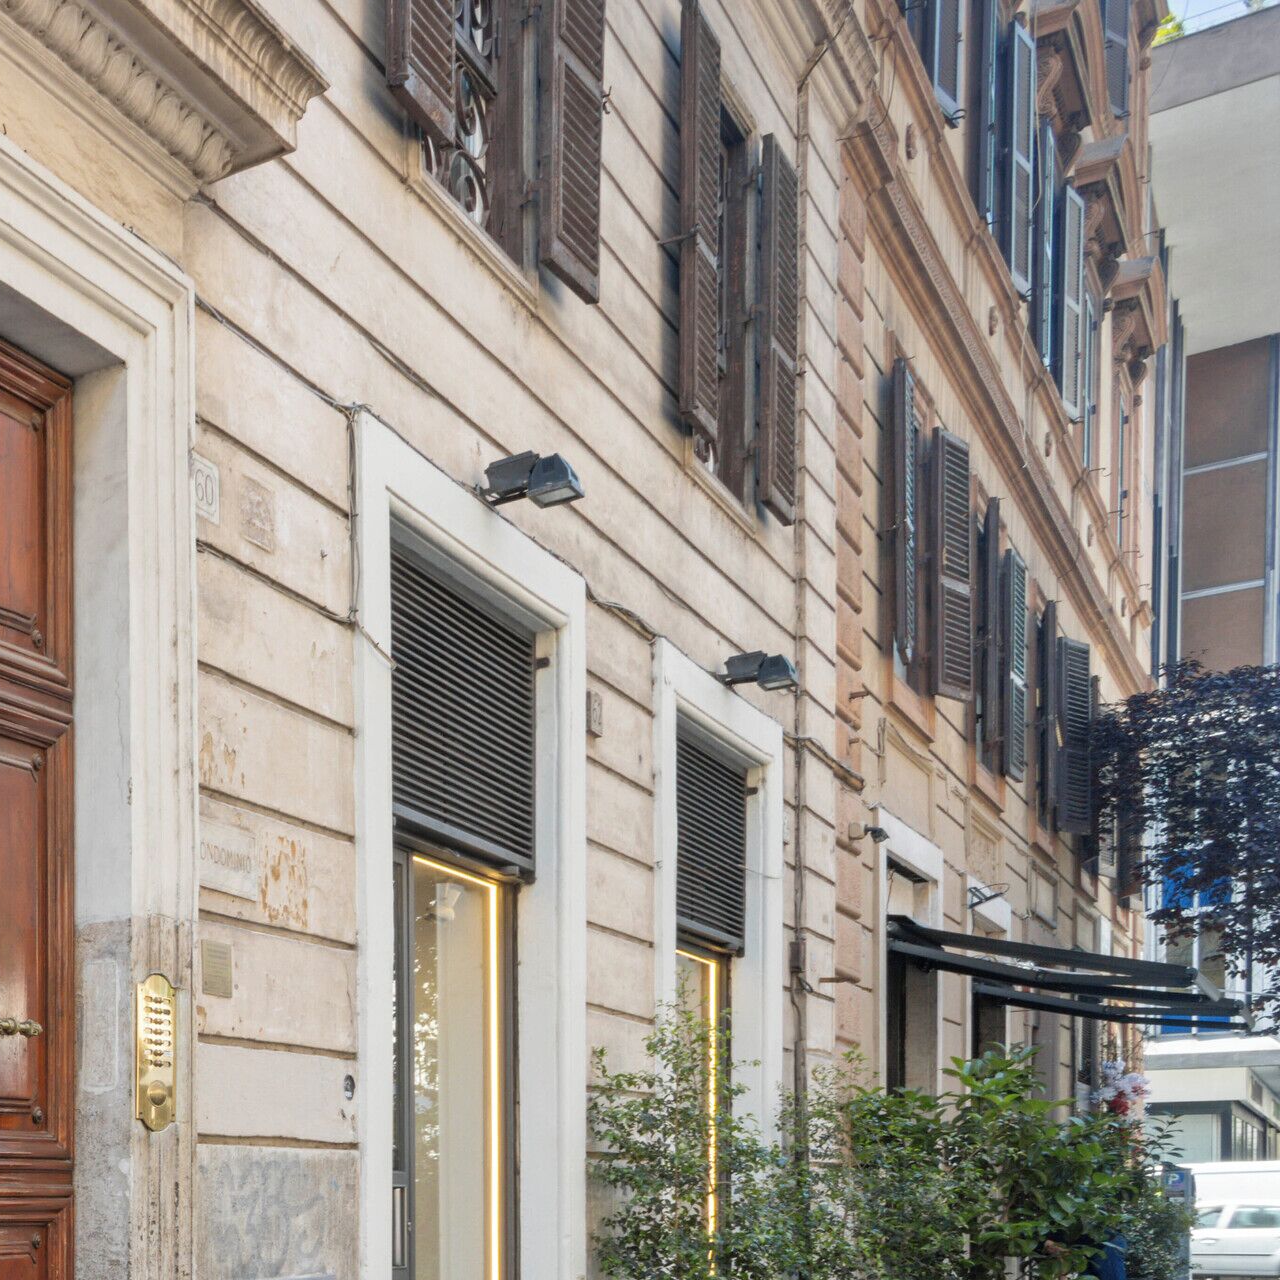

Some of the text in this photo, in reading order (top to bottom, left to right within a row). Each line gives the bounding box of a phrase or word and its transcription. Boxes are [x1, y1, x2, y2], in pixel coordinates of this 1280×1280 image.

[195, 468, 214, 506] 60
[200, 841, 252, 874] ONDOMINIO
[1168, 1173, 1180, 1185] P
